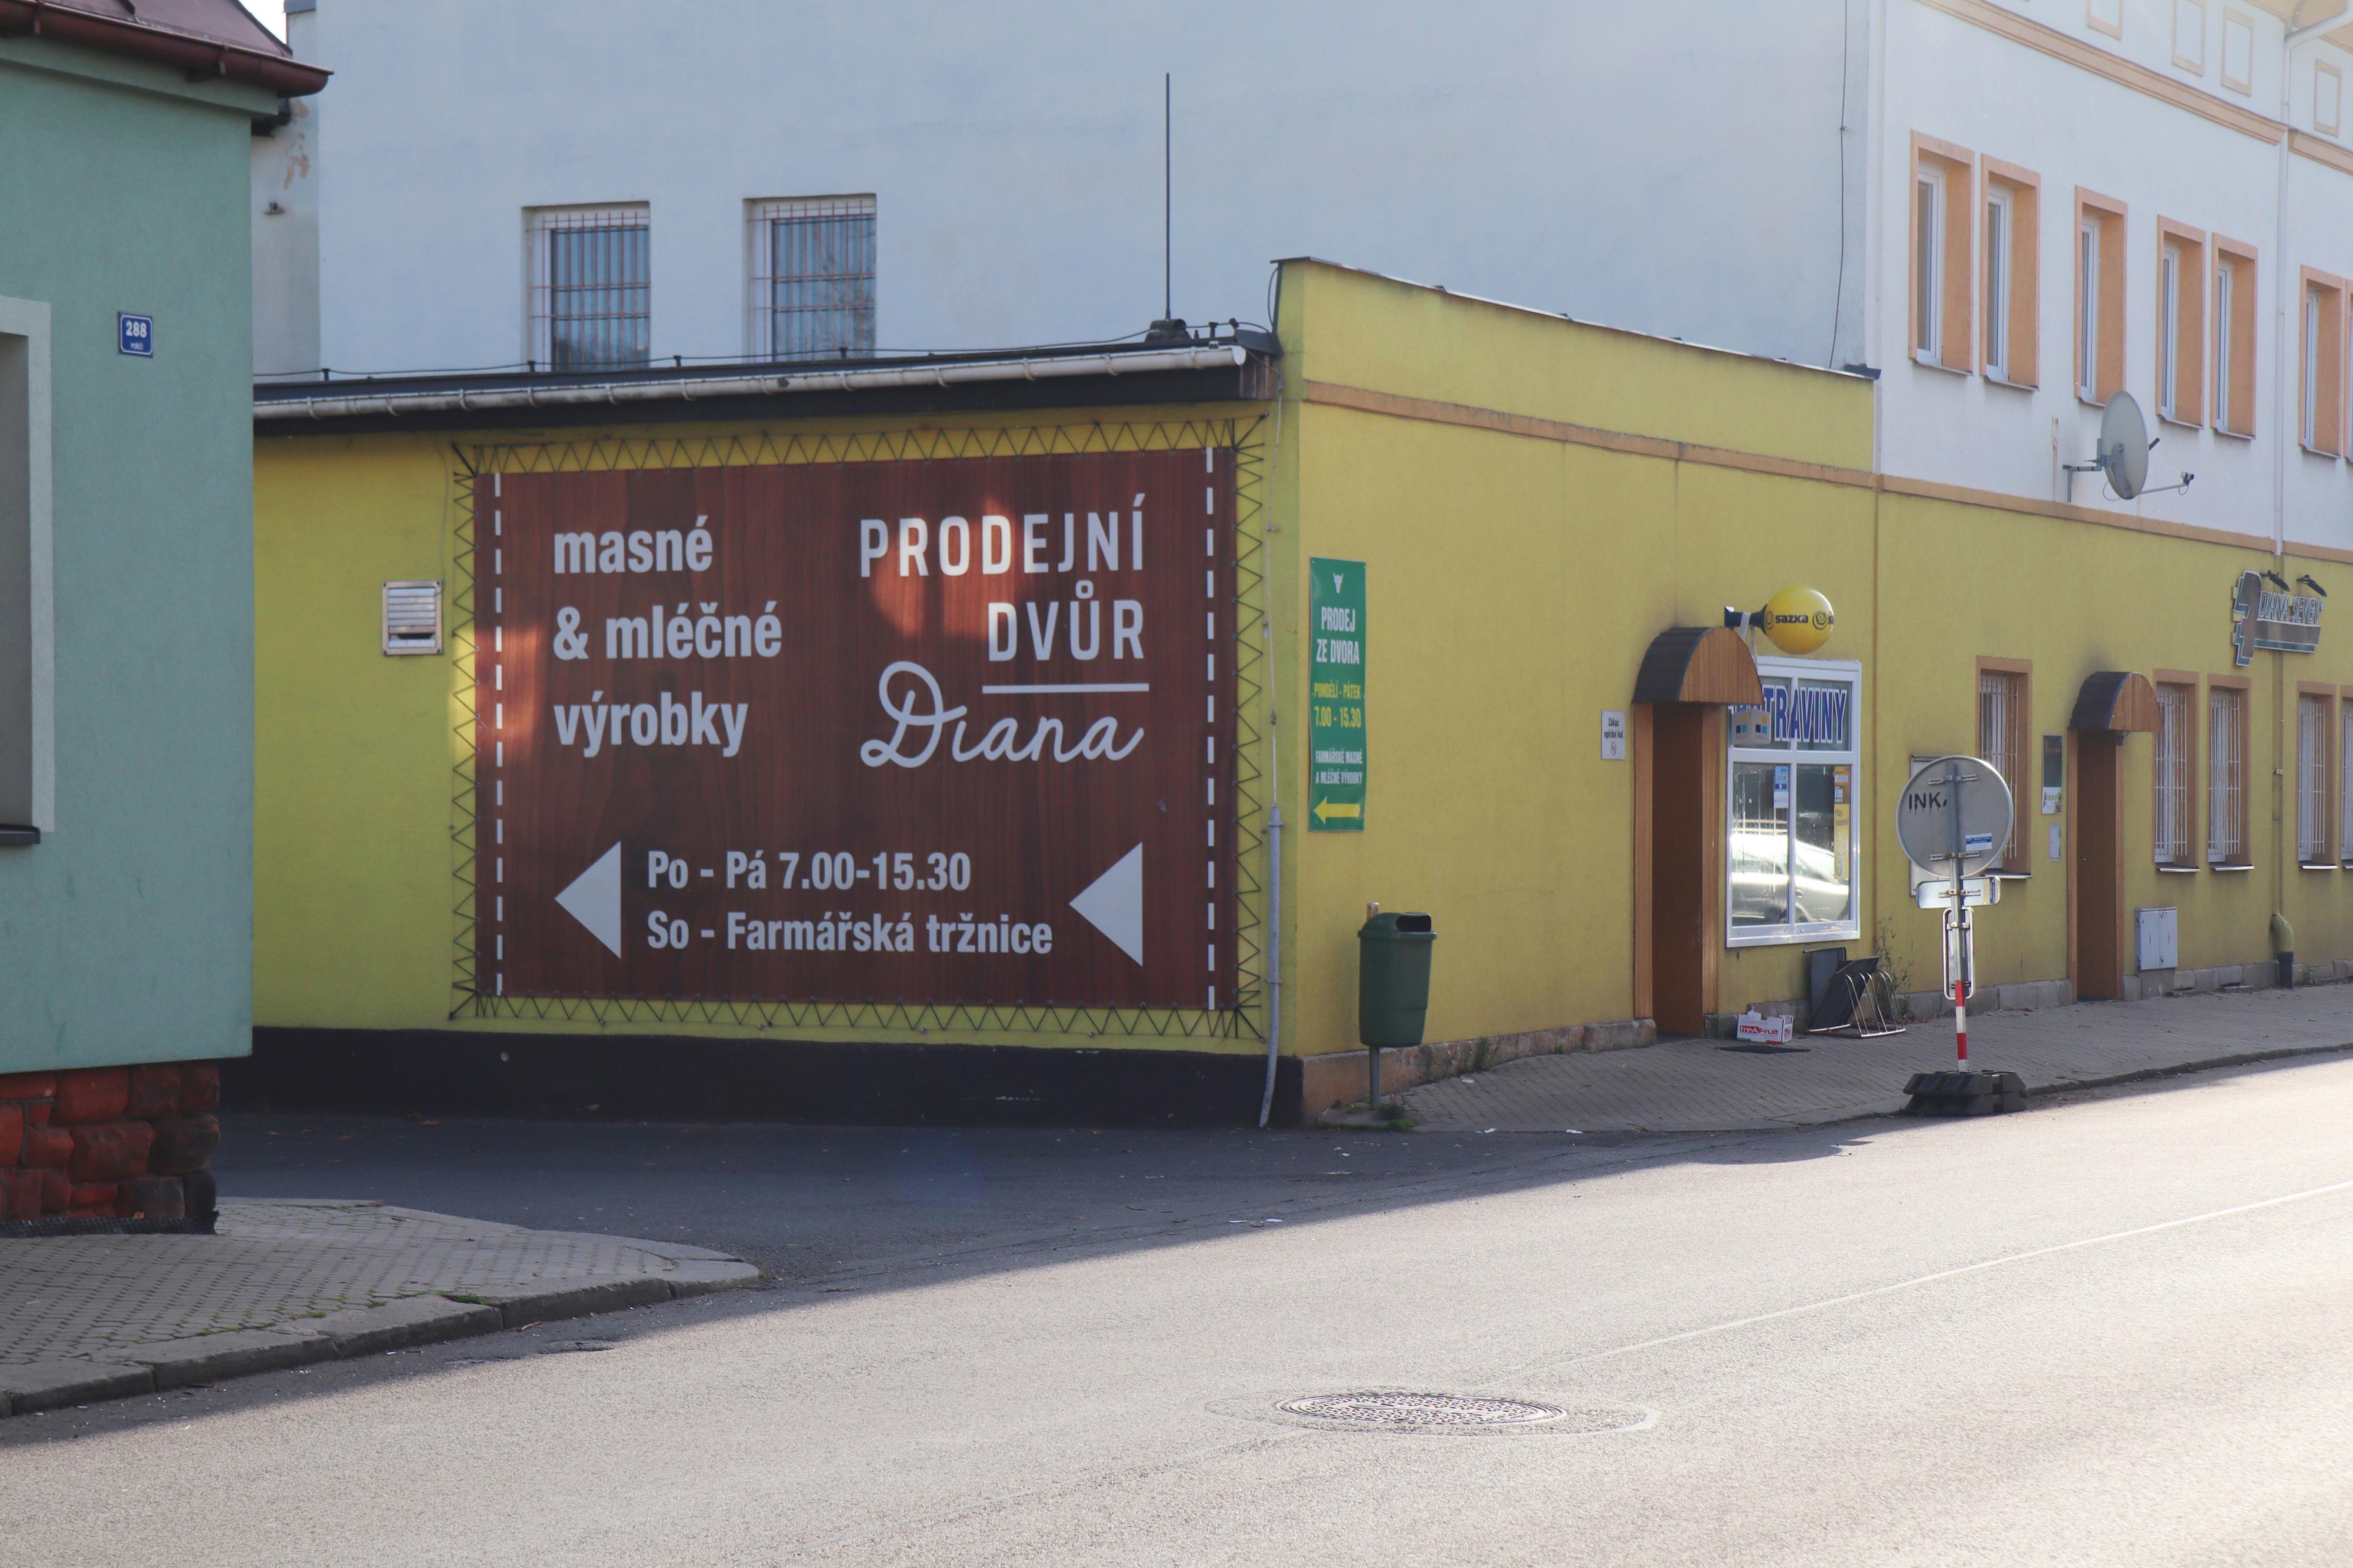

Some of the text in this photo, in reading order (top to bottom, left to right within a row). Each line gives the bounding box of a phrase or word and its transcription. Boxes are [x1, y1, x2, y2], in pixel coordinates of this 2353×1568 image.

[126, 320, 147, 338] 288
[554, 515, 713, 574] masné
[861, 493, 1145, 578] PRODEJNÍ
[988, 580, 1144, 662] DVŮR
[1321, 606, 1355, 632] PRODEJ
[2259, 590, 2319, 625] DIANA SEVEN
[553, 600, 782, 660] & mléčné
[1316, 639, 1359, 665] ZE DVORA
[1314, 679, 1338, 699] PONDĚLÍ
[1343, 680, 1361, 700] PÁTEK
[554, 690, 749, 758] výrobky
[860, 660, 1144, 768] Diana
[1314, 706, 1331, 727] 7.00
[1340, 707, 1361, 728] 15.30
[1735, 684, 1847, 744] TRAVINY
[1315, 747, 1363, 764] FARMÁŘSKÉ MASNÉ
[1315, 768, 1362, 785] A MLÉČNÉ VÝROBKY
[1908, 791, 1948, 813] INK
[648, 850, 971, 891] Po - Pá 7.00-15.30
[648, 910, 1052, 954] So - Farmářská tržnice
